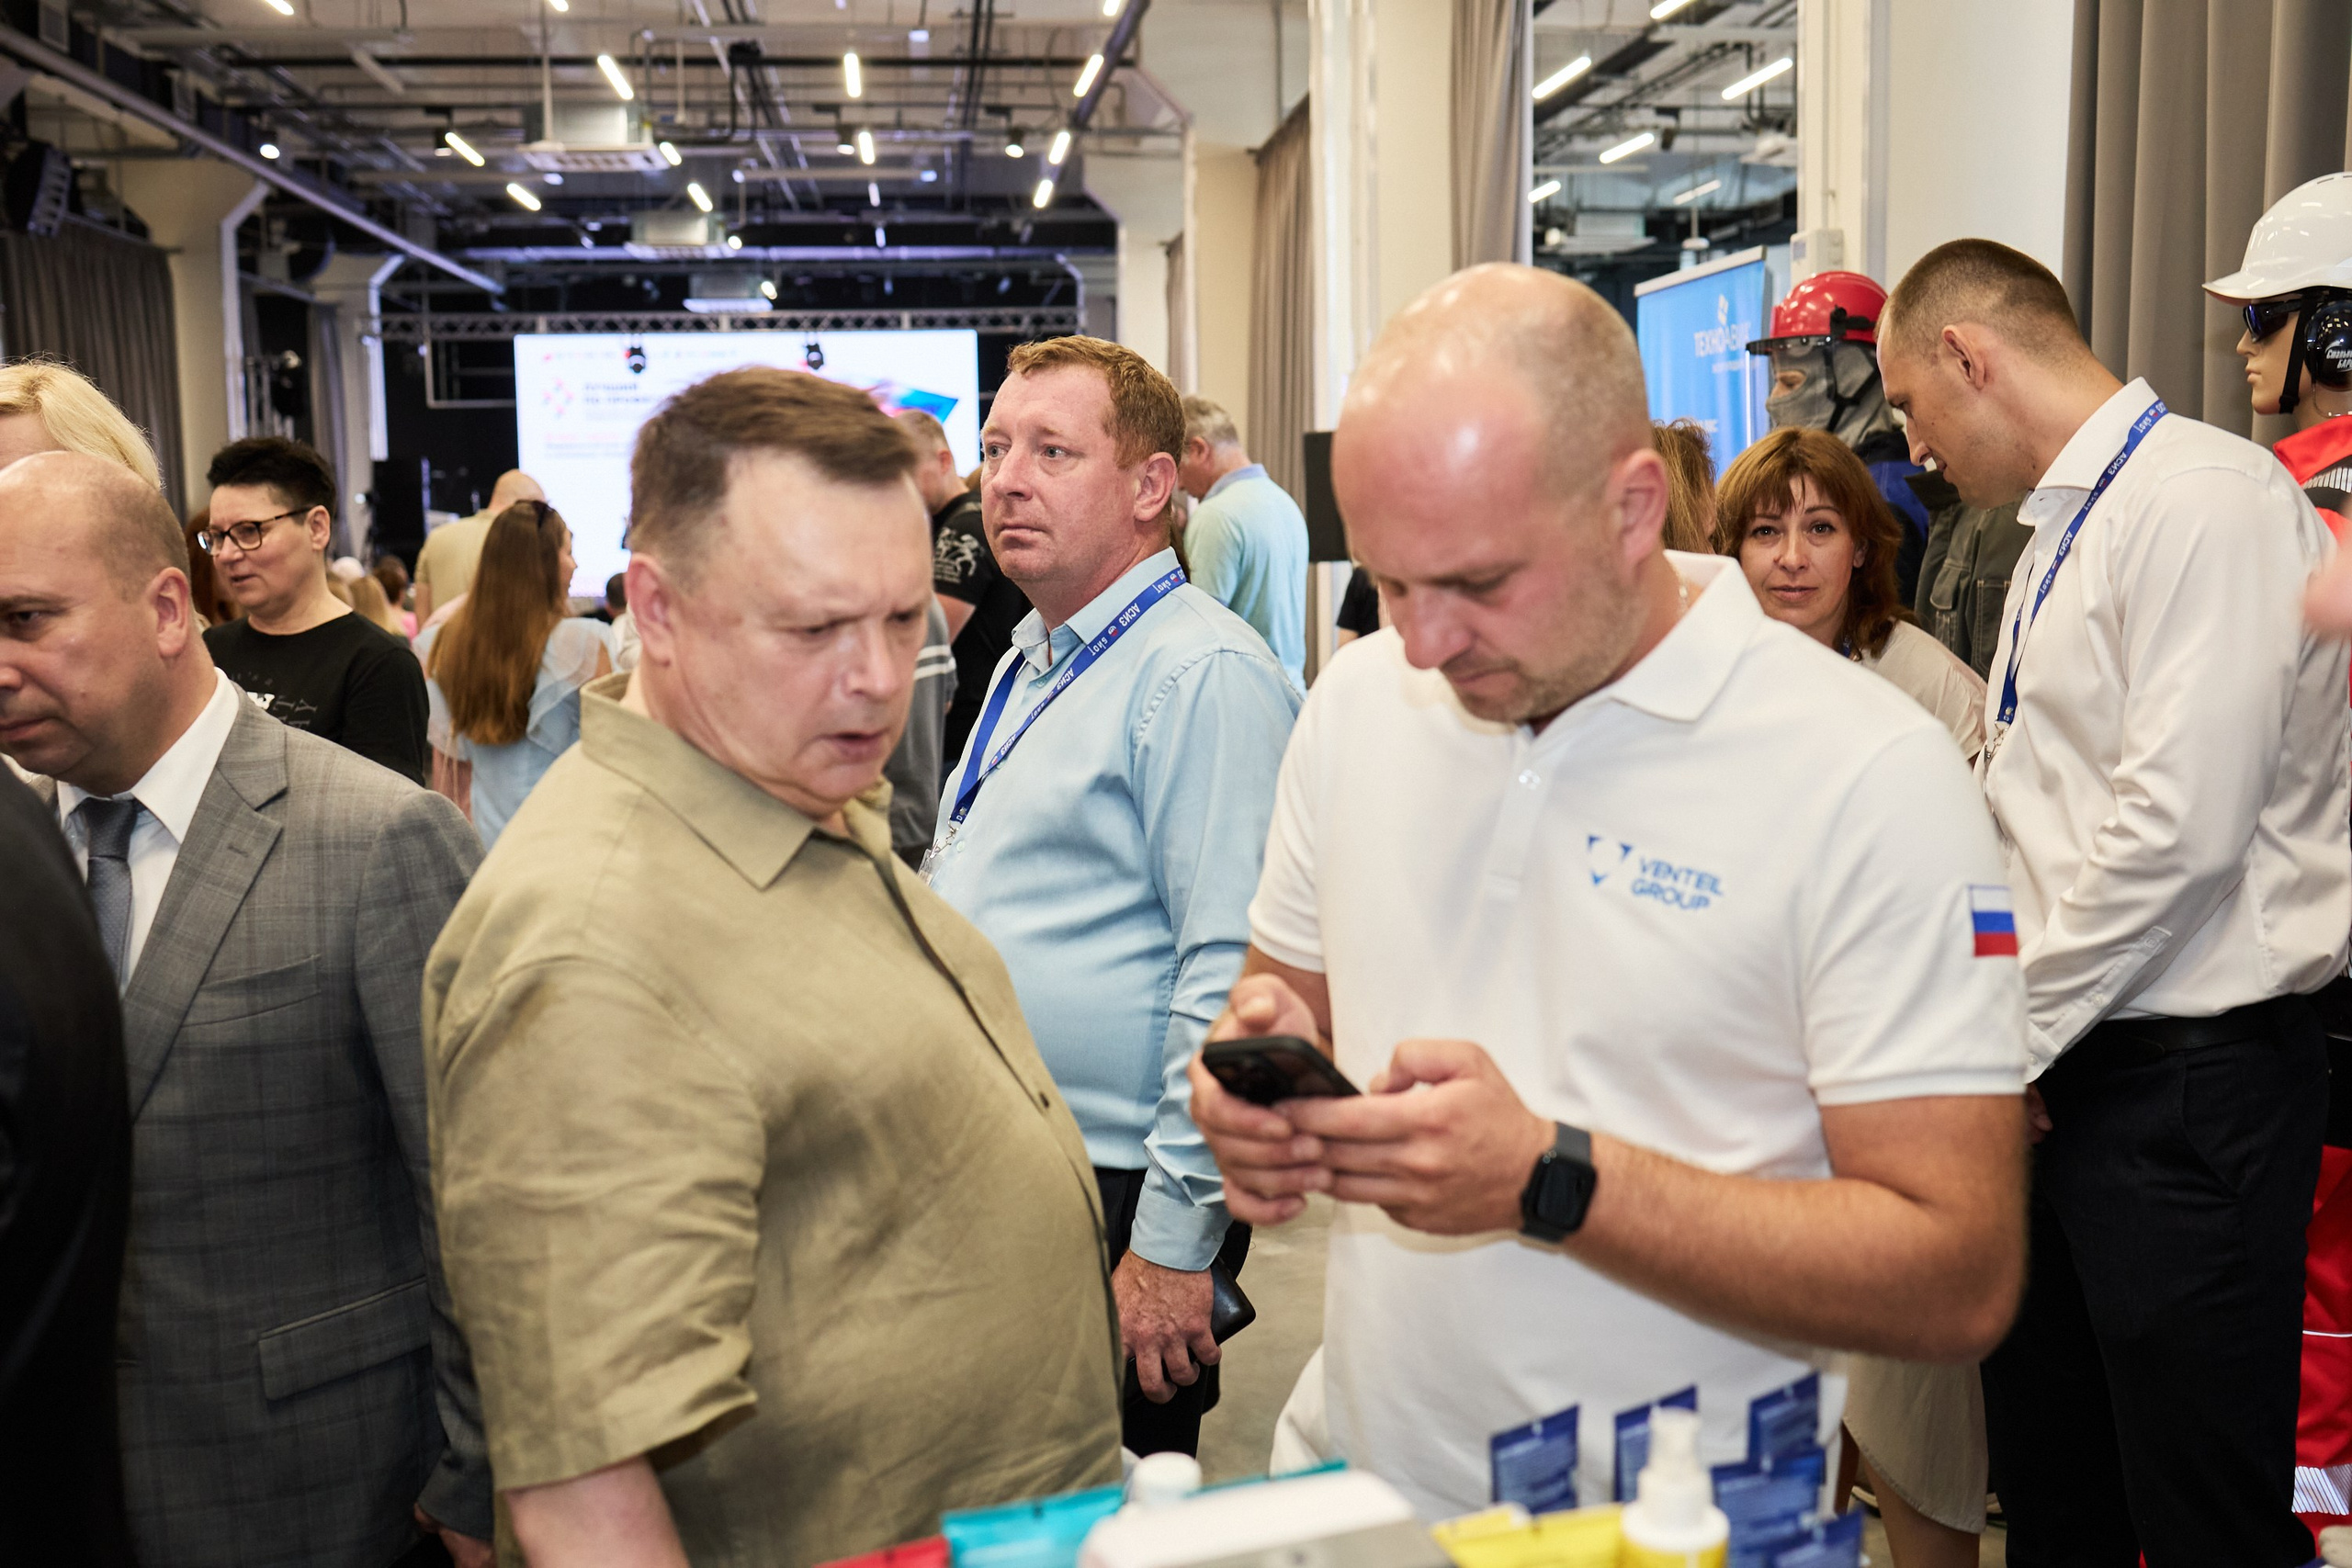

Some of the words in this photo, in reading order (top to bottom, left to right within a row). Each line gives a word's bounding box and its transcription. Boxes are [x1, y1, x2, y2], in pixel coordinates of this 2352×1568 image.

[2108, 452, 2127, 476] АСИЗ
[2059, 530, 2073, 557] АСИЗ
[1118, 603, 1141, 627] АСИЗ
[1057, 667, 1075, 690] АСИЗ
[1001, 734, 1016, 755] АСИЗ
[1632, 878, 1710, 908] GROUP
